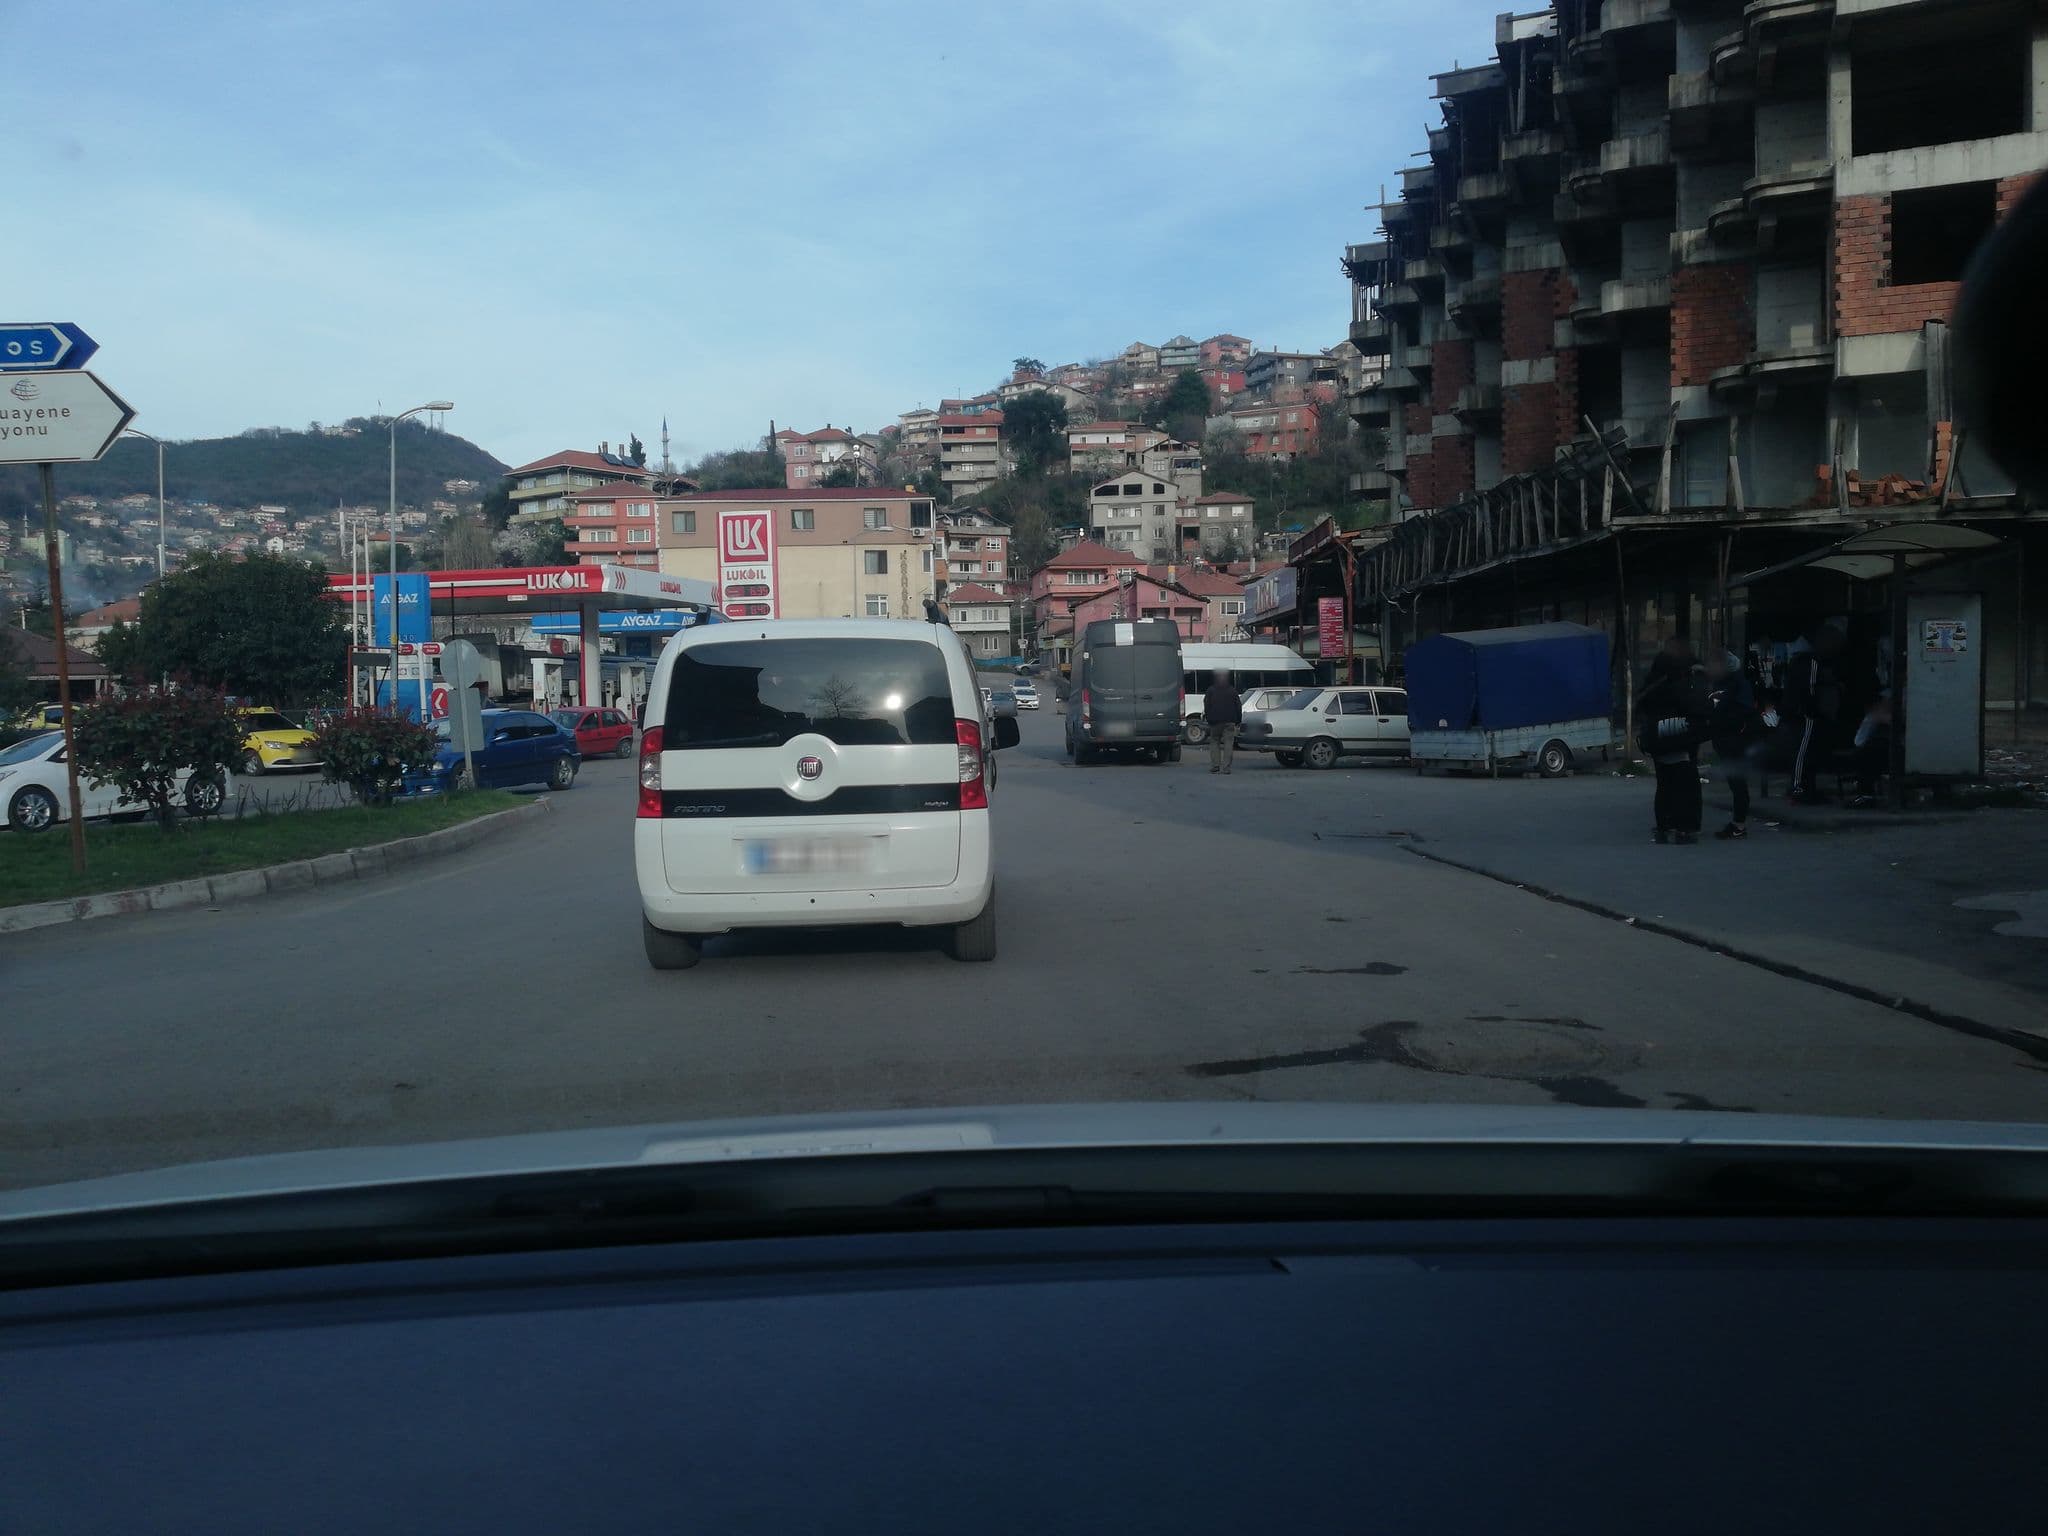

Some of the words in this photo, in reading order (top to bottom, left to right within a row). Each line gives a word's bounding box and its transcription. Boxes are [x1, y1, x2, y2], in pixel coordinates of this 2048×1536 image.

[0, 425, 48, 440] yonu
[727, 519, 766, 556] LUK
[527, 570, 589, 590] LUKOIL
[726, 568, 767, 581] LUKOIL
[660, 581, 682, 594] LUKOIL
[621, 615, 661, 626] AYGAZ
[802, 762, 818, 774] FIAT
